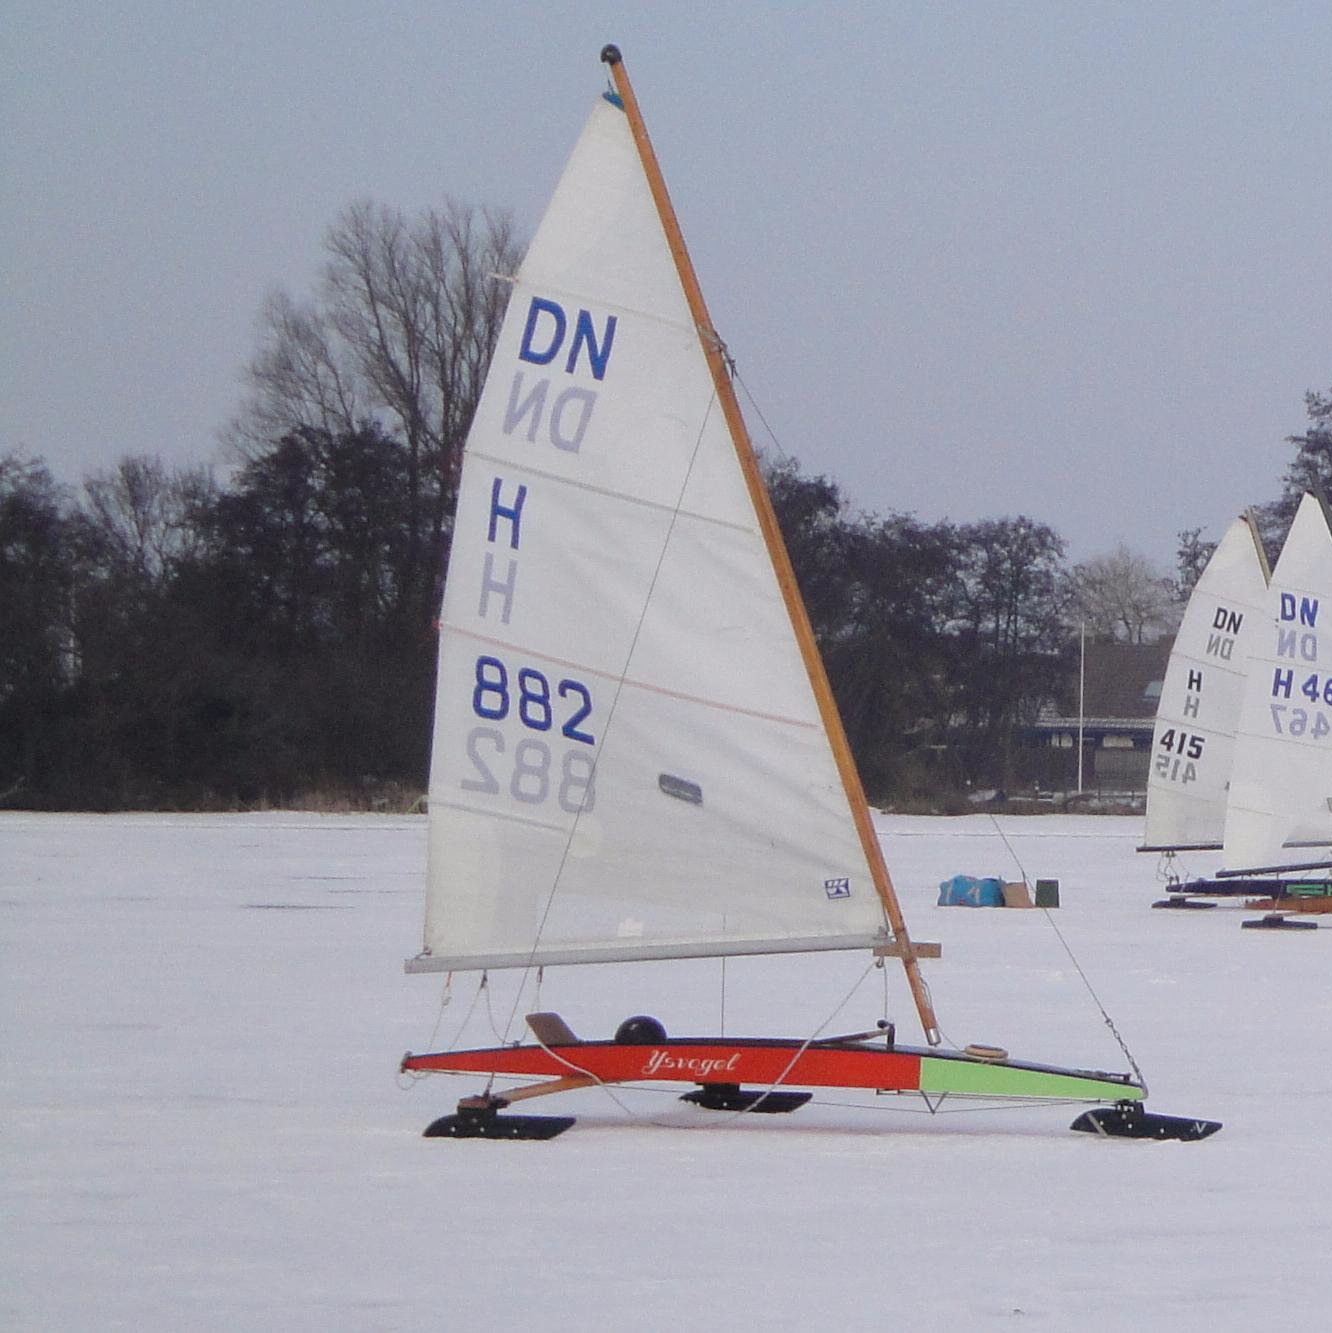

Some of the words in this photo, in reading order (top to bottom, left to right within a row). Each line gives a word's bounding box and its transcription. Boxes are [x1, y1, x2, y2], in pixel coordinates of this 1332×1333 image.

[518, 296, 618, 381] DN
[488, 478, 527, 549] H
[1212, 607, 1243, 635] DN
[1280, 592, 1319, 628] DN
[1188, 669, 1202, 692] H
[1271, 668, 1294, 699] H
[472, 655, 595, 745] 882
[1160, 729, 1206, 759] 415
